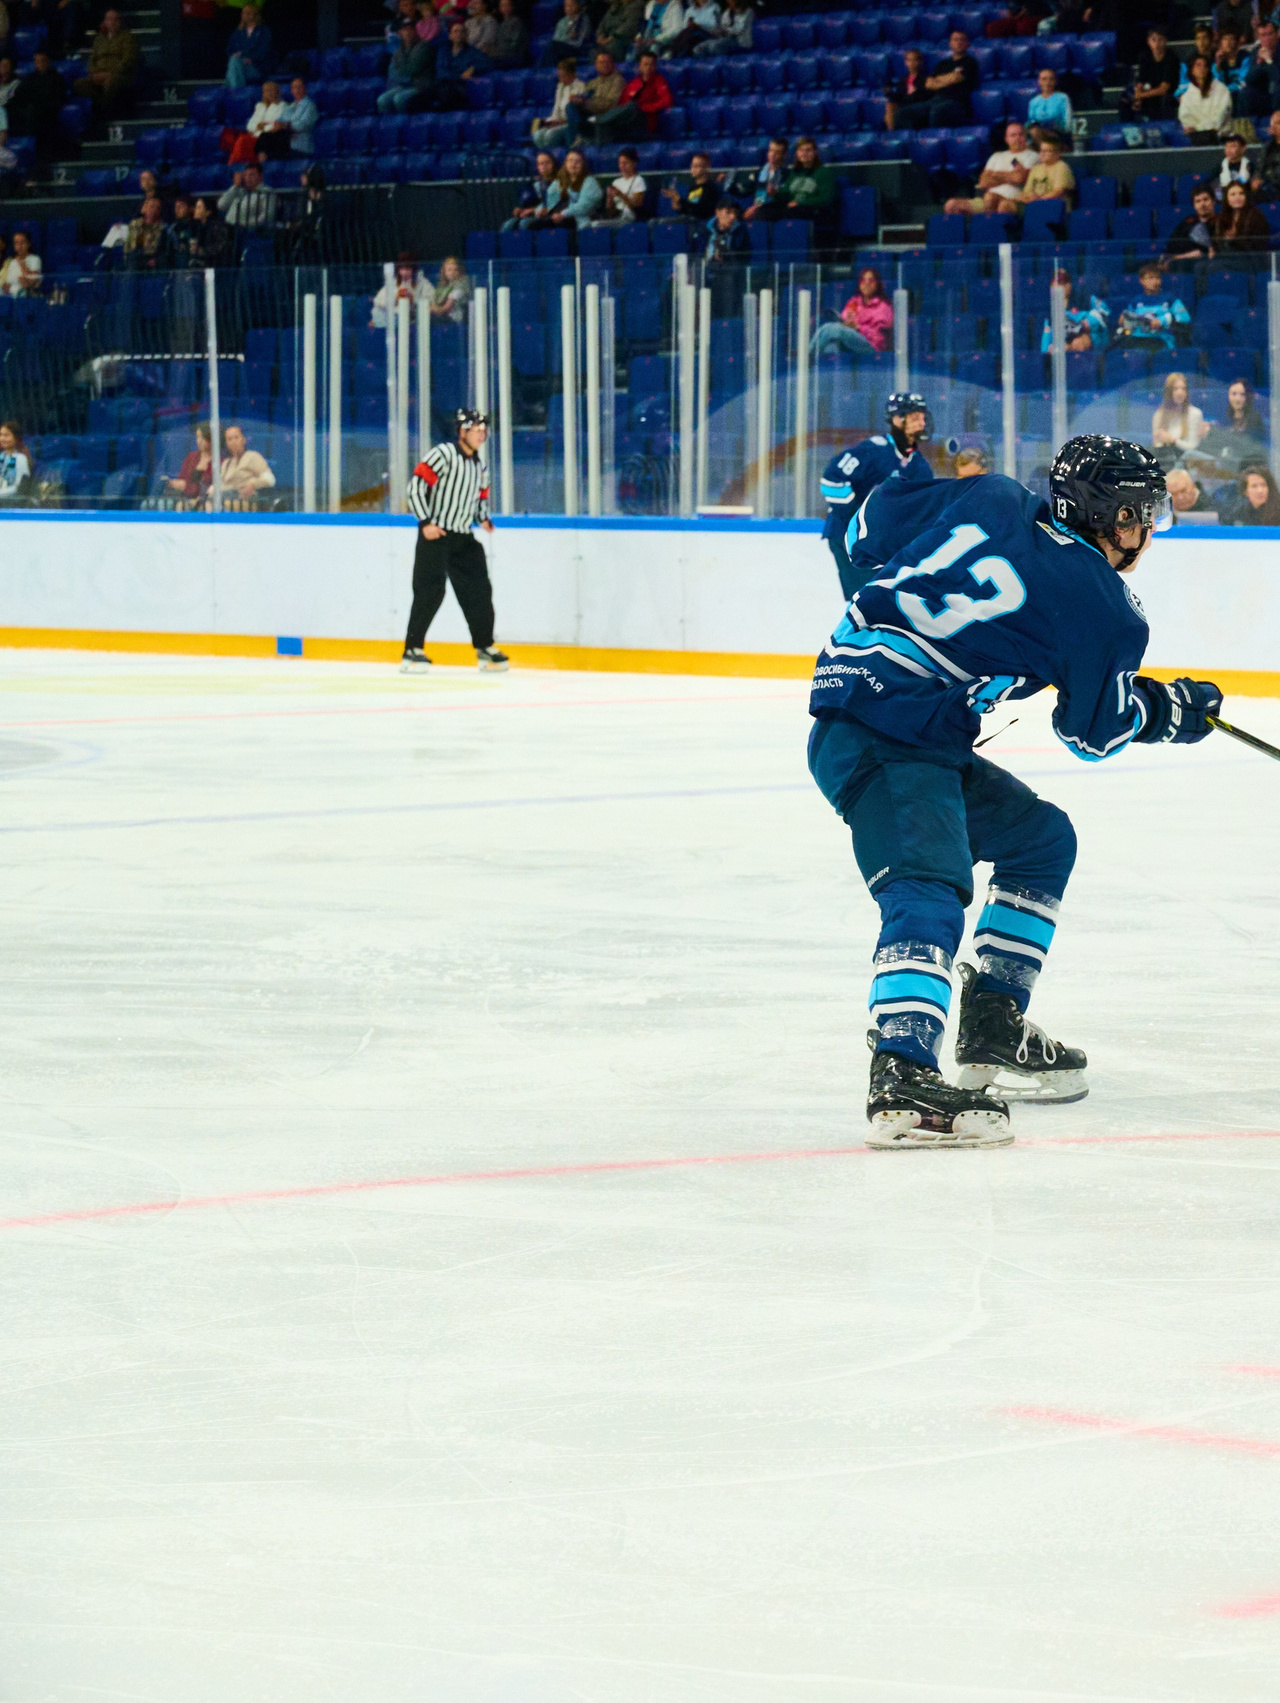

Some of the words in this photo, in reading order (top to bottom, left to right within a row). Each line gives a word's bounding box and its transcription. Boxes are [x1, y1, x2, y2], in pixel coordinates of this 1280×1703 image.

[837, 452, 860, 476] 18
[1118, 480, 1146, 488] BAUER
[1056, 497, 1068, 519] 13
[865, 523, 1028, 640] 13
[1161, 683, 1182, 743] UER
